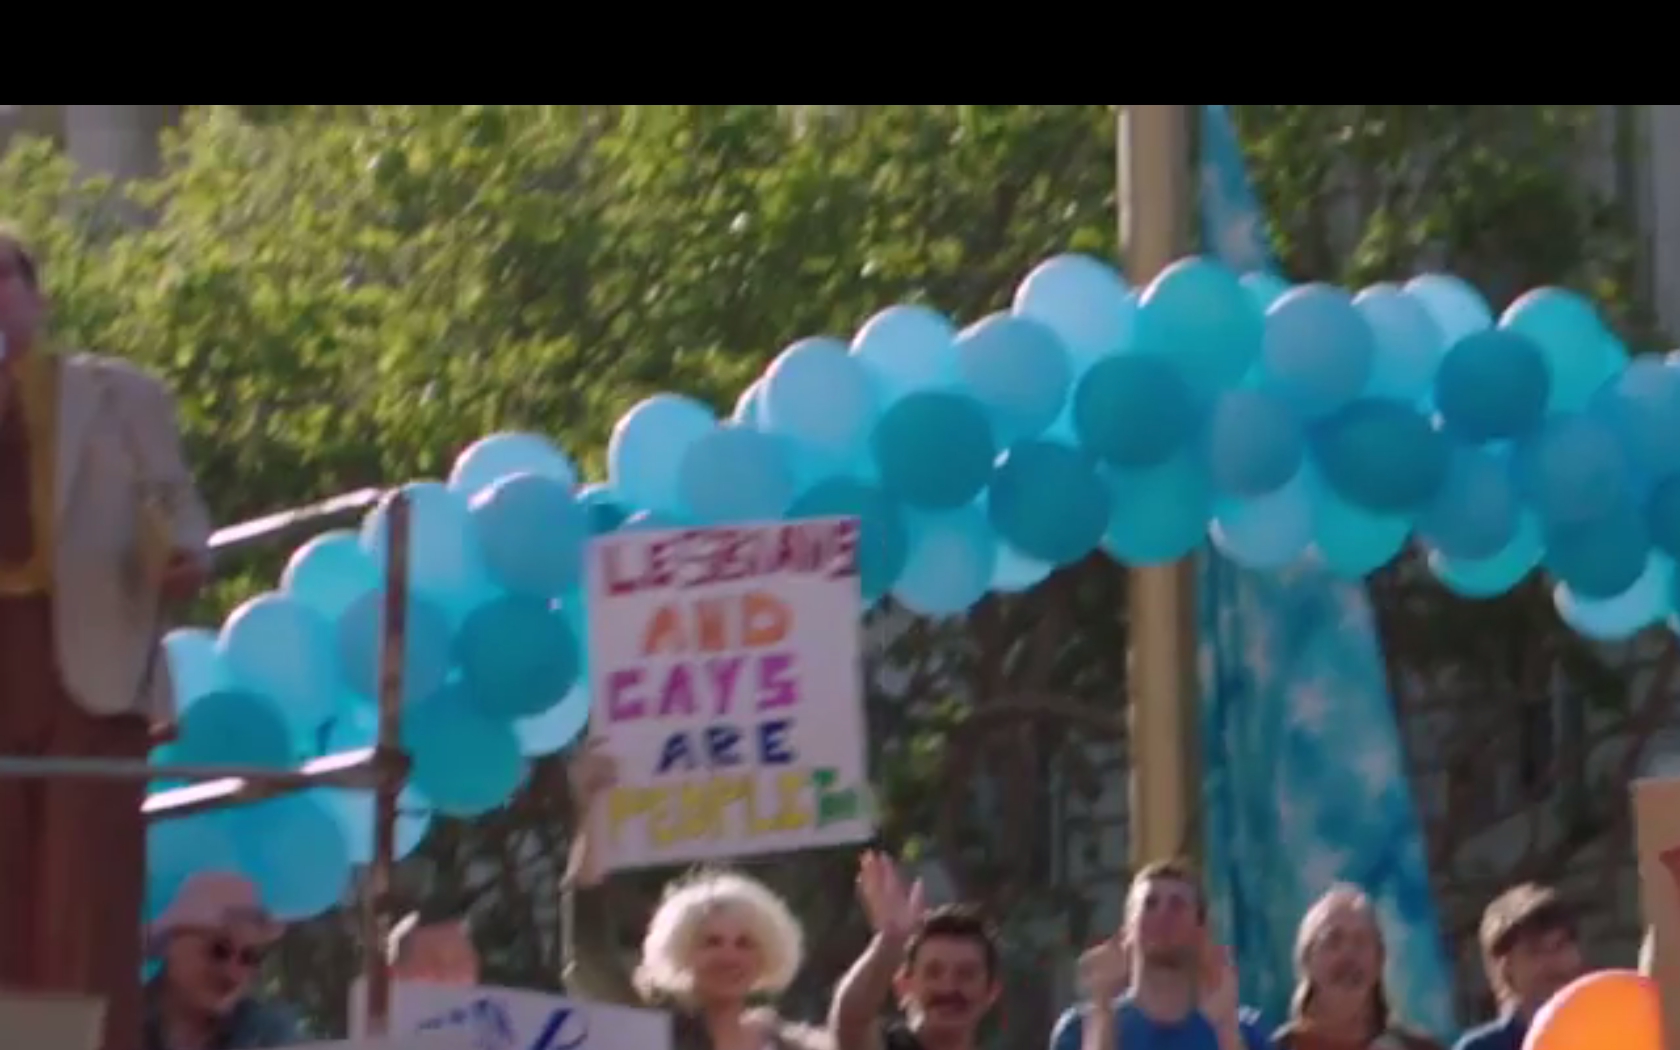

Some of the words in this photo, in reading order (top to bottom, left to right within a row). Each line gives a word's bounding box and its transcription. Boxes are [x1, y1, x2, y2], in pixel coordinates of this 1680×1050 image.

[642, 594, 790, 654] AND
[606, 654, 800, 721] GAYS
[654, 719, 794, 772] ARE
